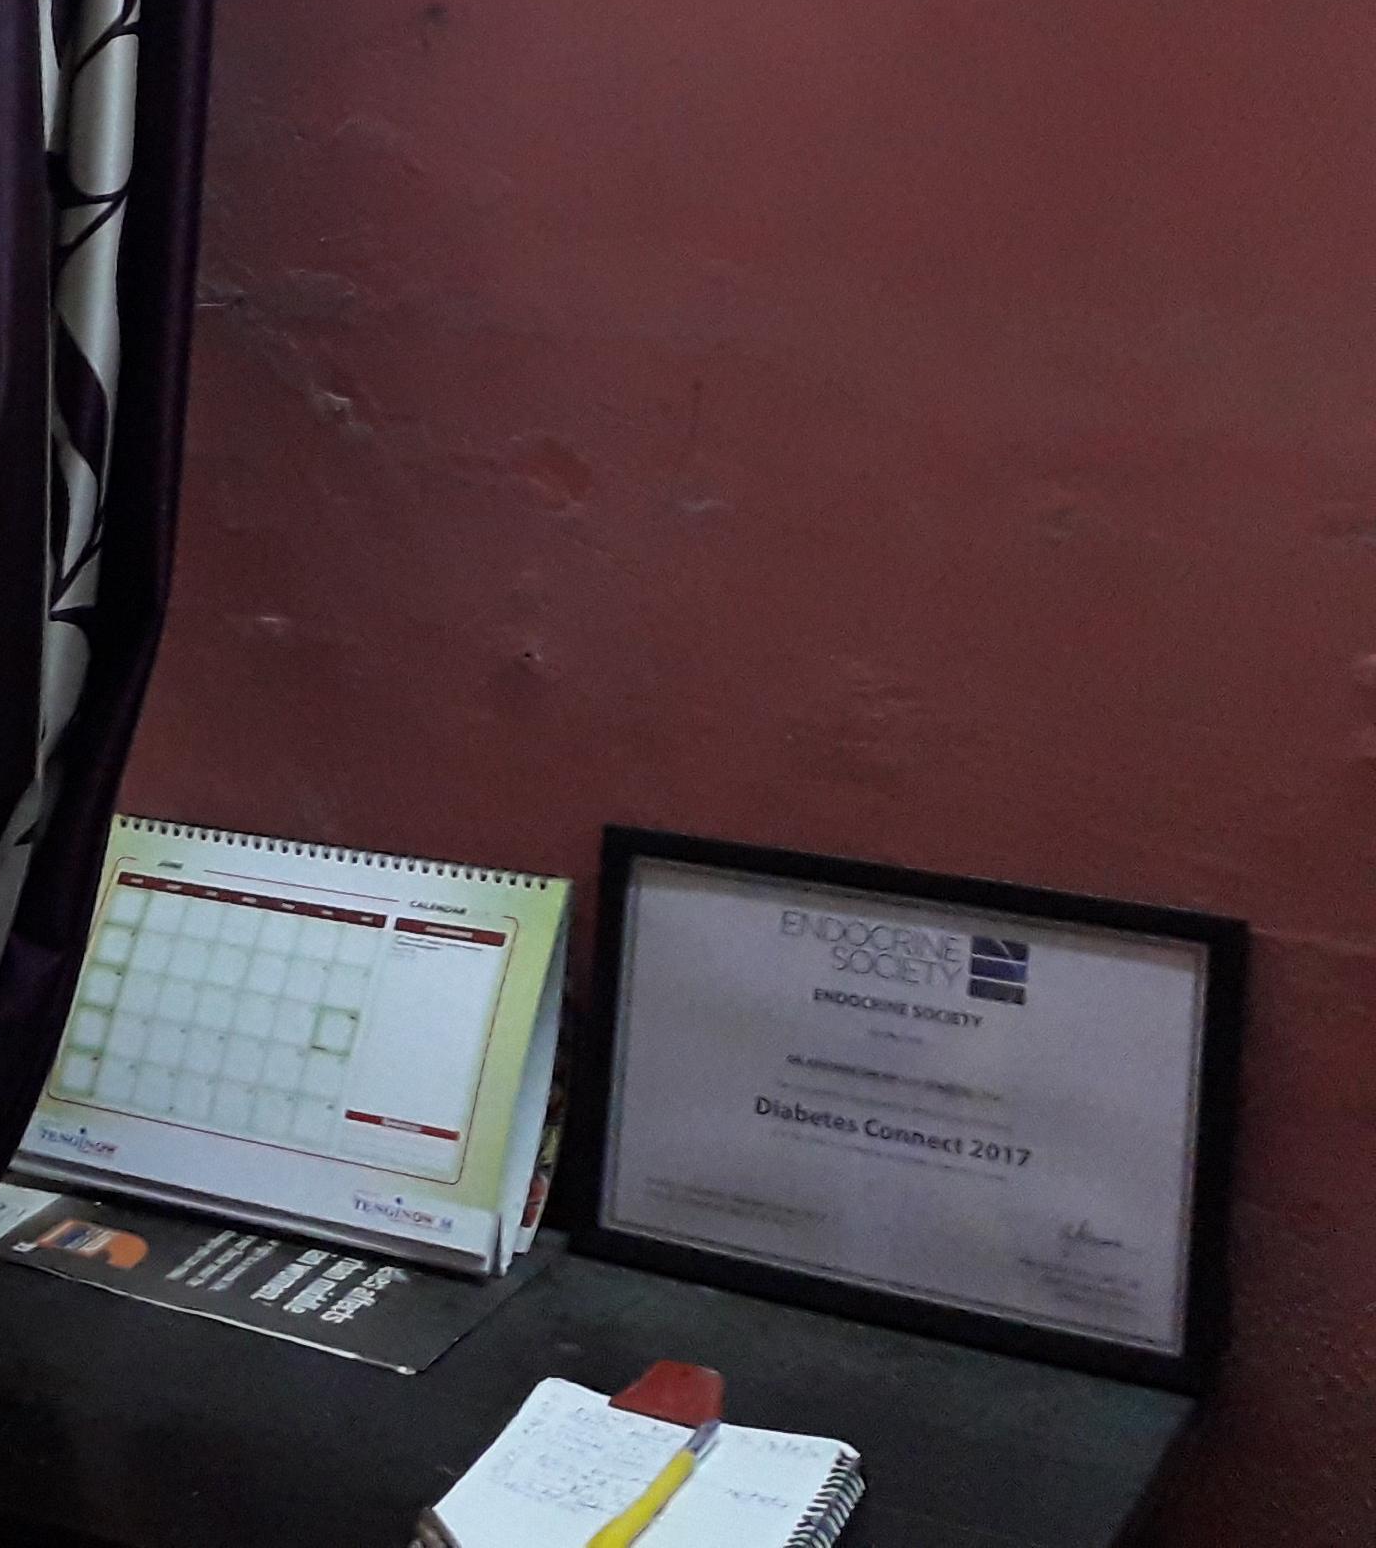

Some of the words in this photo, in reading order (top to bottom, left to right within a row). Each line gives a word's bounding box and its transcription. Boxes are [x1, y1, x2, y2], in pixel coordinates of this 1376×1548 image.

[780, 910, 960, 963] ENDOCRINE
[831, 946, 964, 987] SOCIETY
[813, 988, 909, 1018] ENDOCRINE
[913, 1004, 984, 1028] SOCIETY
[754, 1096, 858, 1133] Diabetes
[864, 1117, 963, 1156] Connect
[971, 1139, 1033, 1167] 2017
